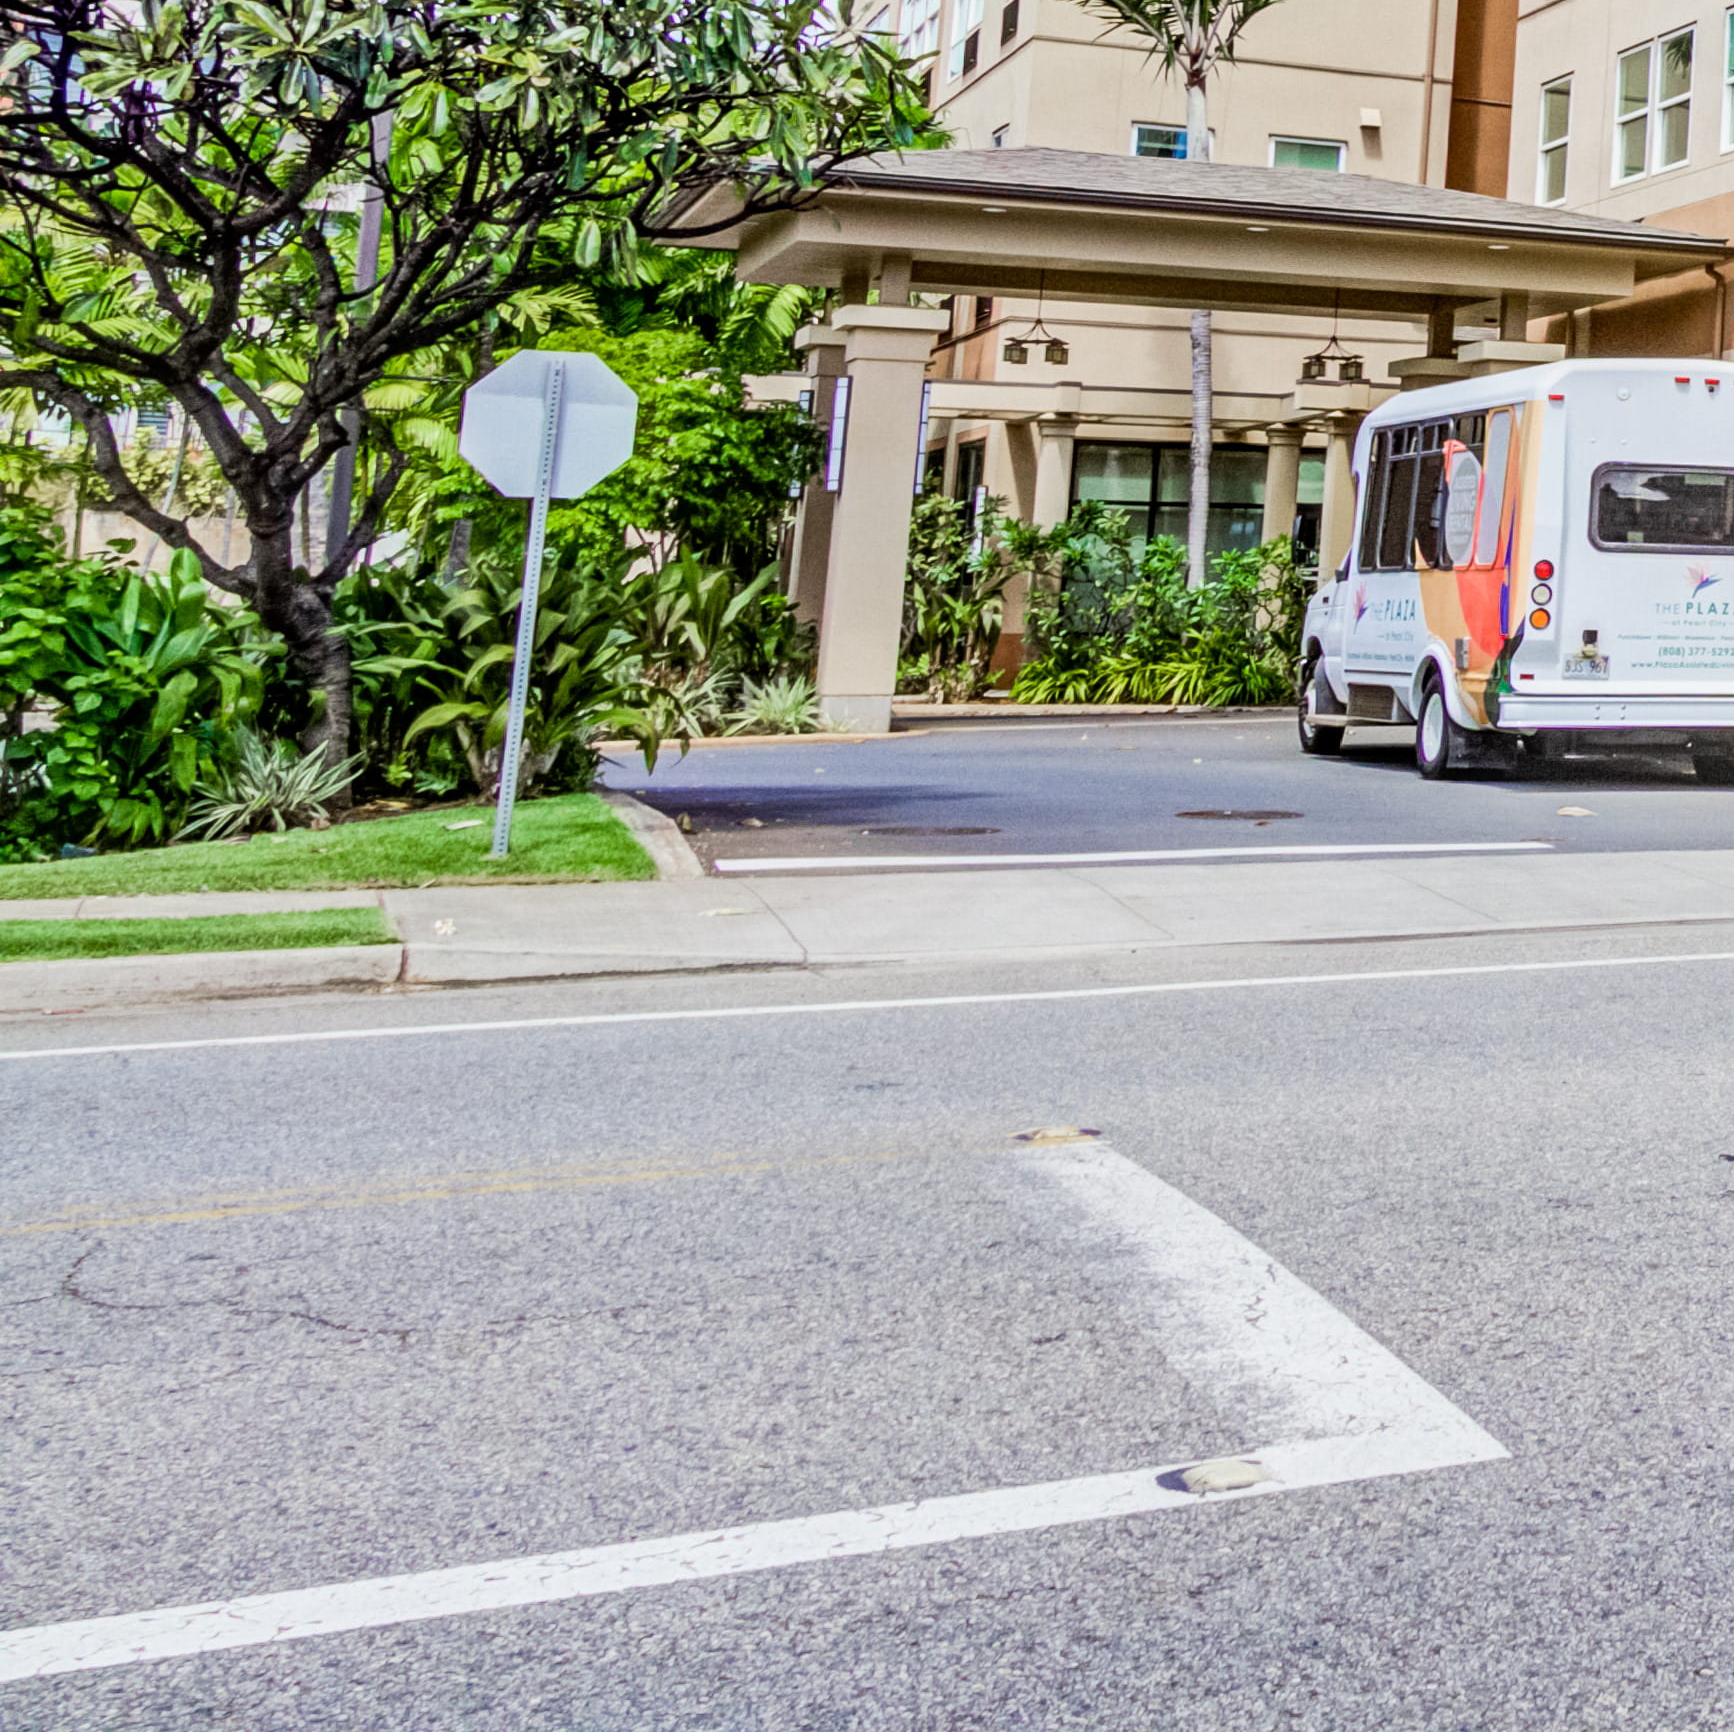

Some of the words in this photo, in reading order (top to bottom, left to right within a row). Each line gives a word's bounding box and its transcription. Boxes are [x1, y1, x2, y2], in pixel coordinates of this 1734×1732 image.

[1384, 599, 1416, 620] PLAZA
[1656, 603, 1680, 615] THE
[1658, 647, 1686, 657] (808)
